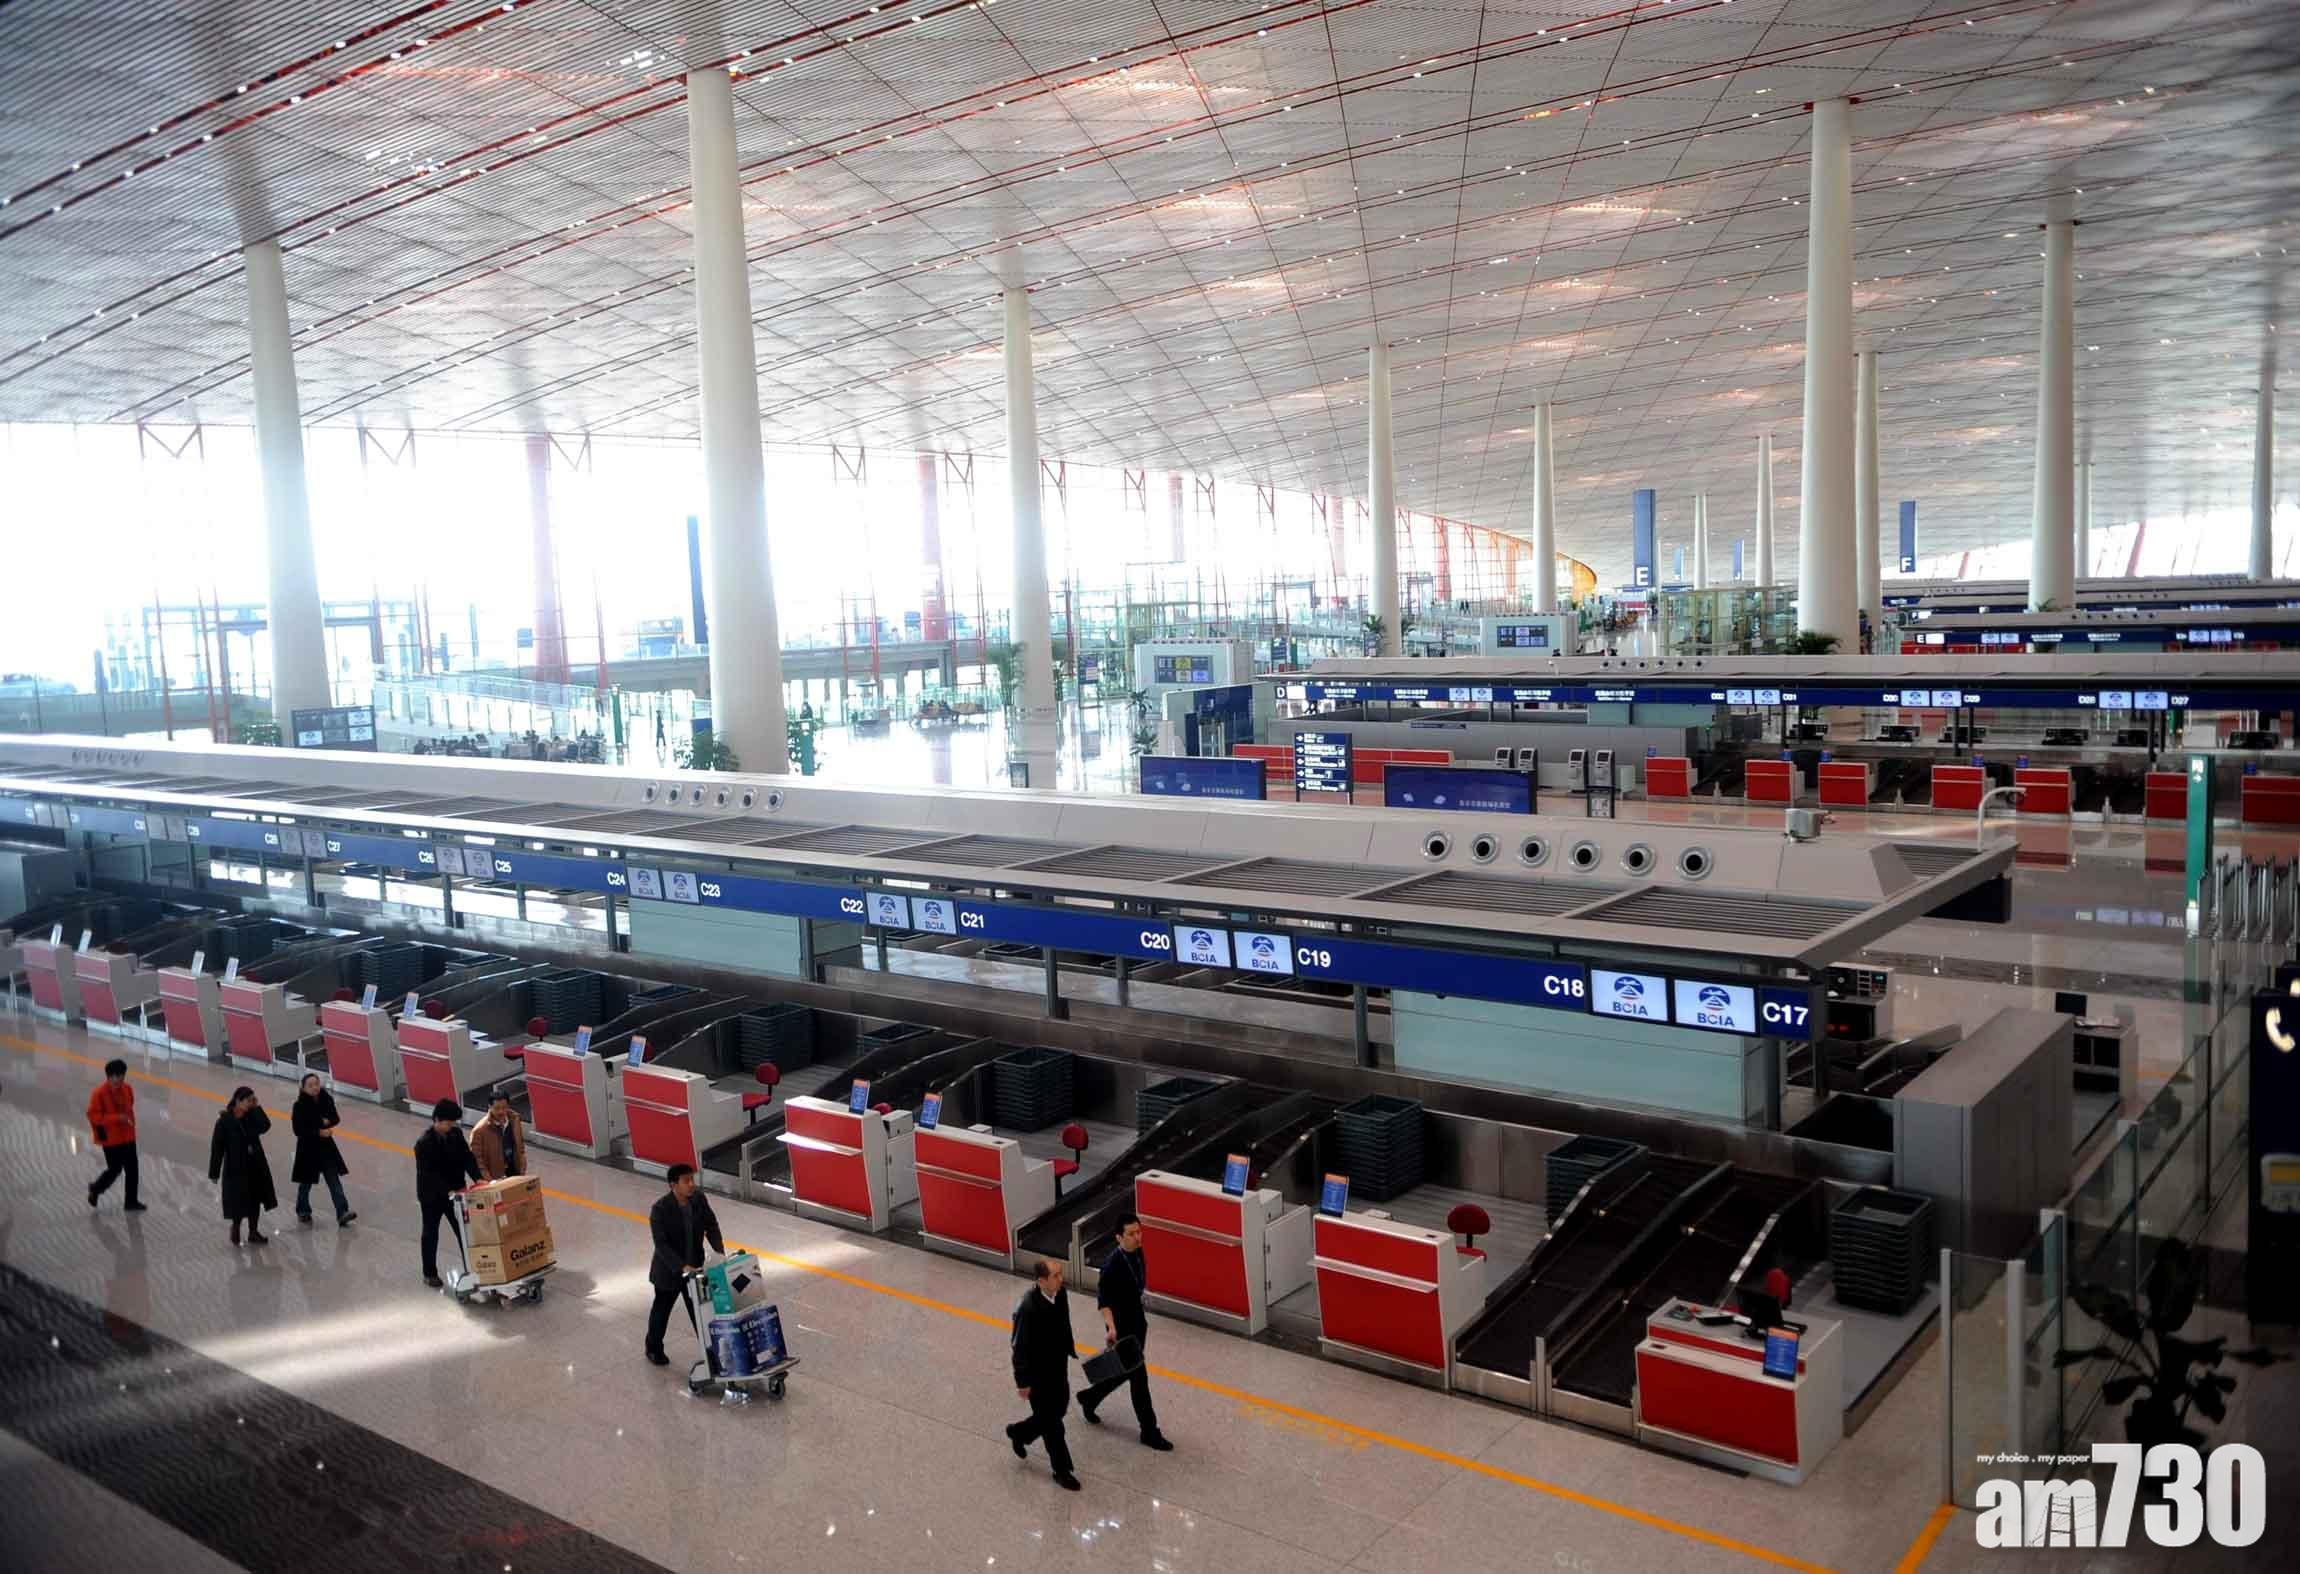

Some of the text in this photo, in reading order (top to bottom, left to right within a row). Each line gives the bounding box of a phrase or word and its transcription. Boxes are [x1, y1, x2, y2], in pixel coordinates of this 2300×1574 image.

[1901, 557, 1912, 571] F
[1636, 567, 1648, 585] E
[1917, 634, 1924, 643] E
[1276, 687, 1286, 698] D
[495, 860, 512, 873] C25
[607, 872, 626, 886] C24
[700, 882, 721, 898] C23
[840, 897, 864, 914] C22
[879, 914, 900, 926] BCIA
[925, 920, 946, 931] BCIA
[960, 911, 985, 929] C21
[1140, 931, 1171, 950] C20
[1191, 952, 1217, 964] BCIA
[1251, 958, 1279, 971] BCIA
[1297, 947, 1331, 968] C19
[1543, 975, 1585, 998] C18
[1612, 1001, 1649, 1017] BCIA
[1762, 1002, 1809, 1026] C17
[1697, 1011, 1735, 1028] BCIA
[510, 1240, 545, 1261] Galanz
